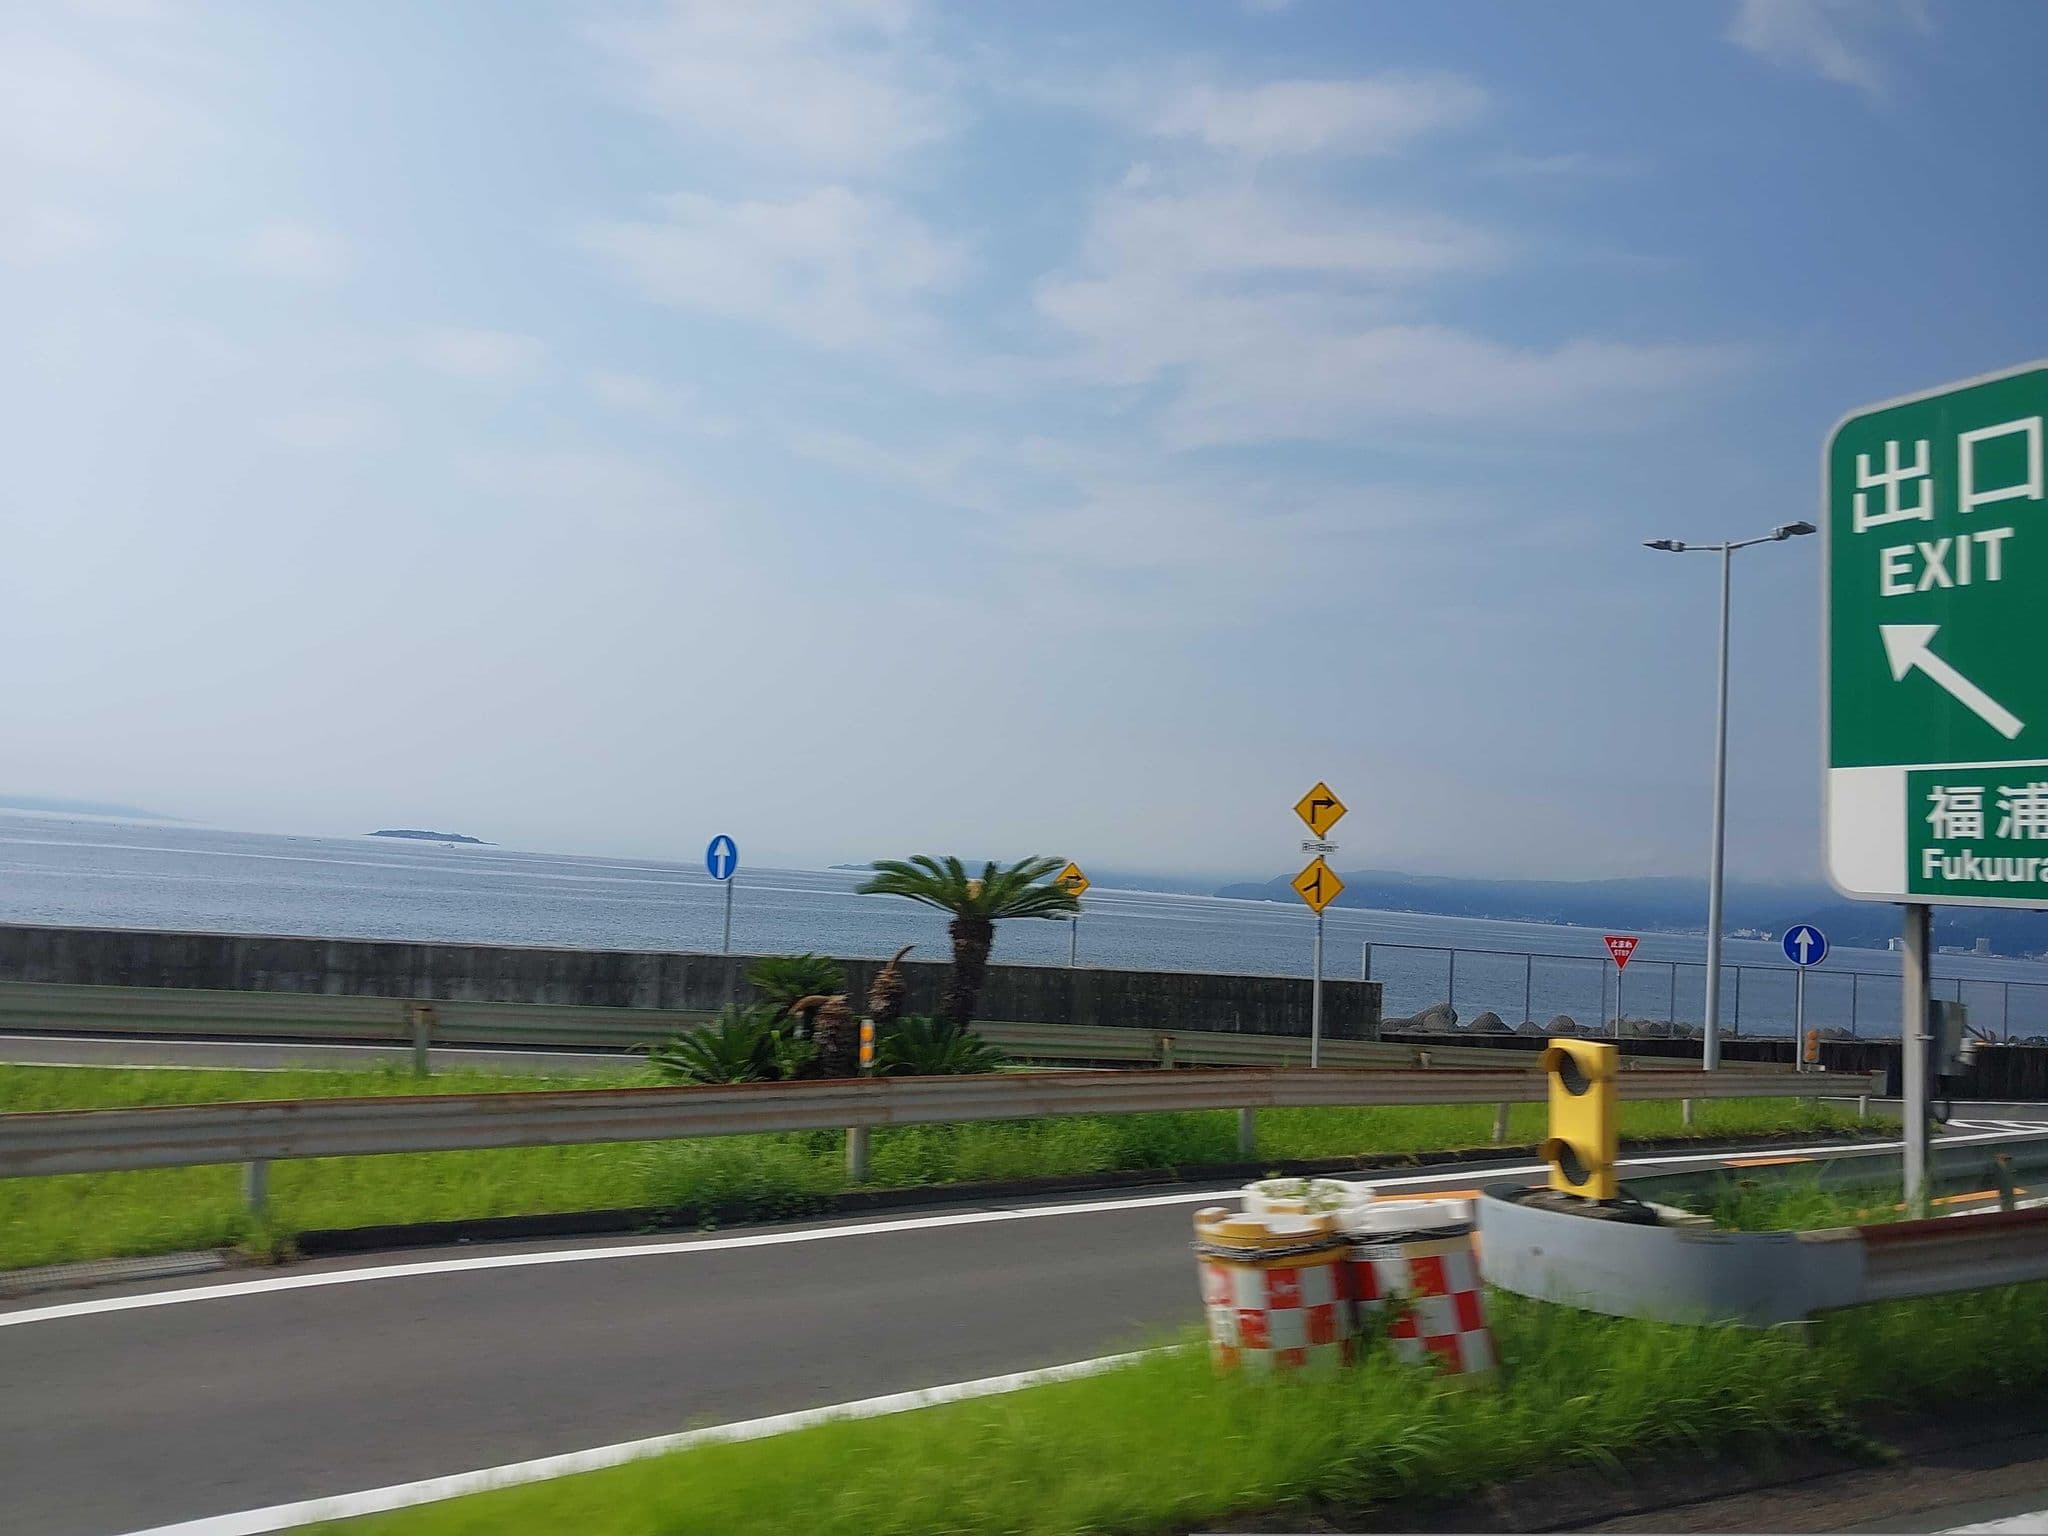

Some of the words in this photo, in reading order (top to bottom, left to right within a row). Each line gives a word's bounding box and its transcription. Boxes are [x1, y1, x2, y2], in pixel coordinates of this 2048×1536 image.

[1853, 416, 2044, 534] 出口
[1879, 527, 2015, 598] EXIT
[1925, 782, 2048, 839] 福浦
